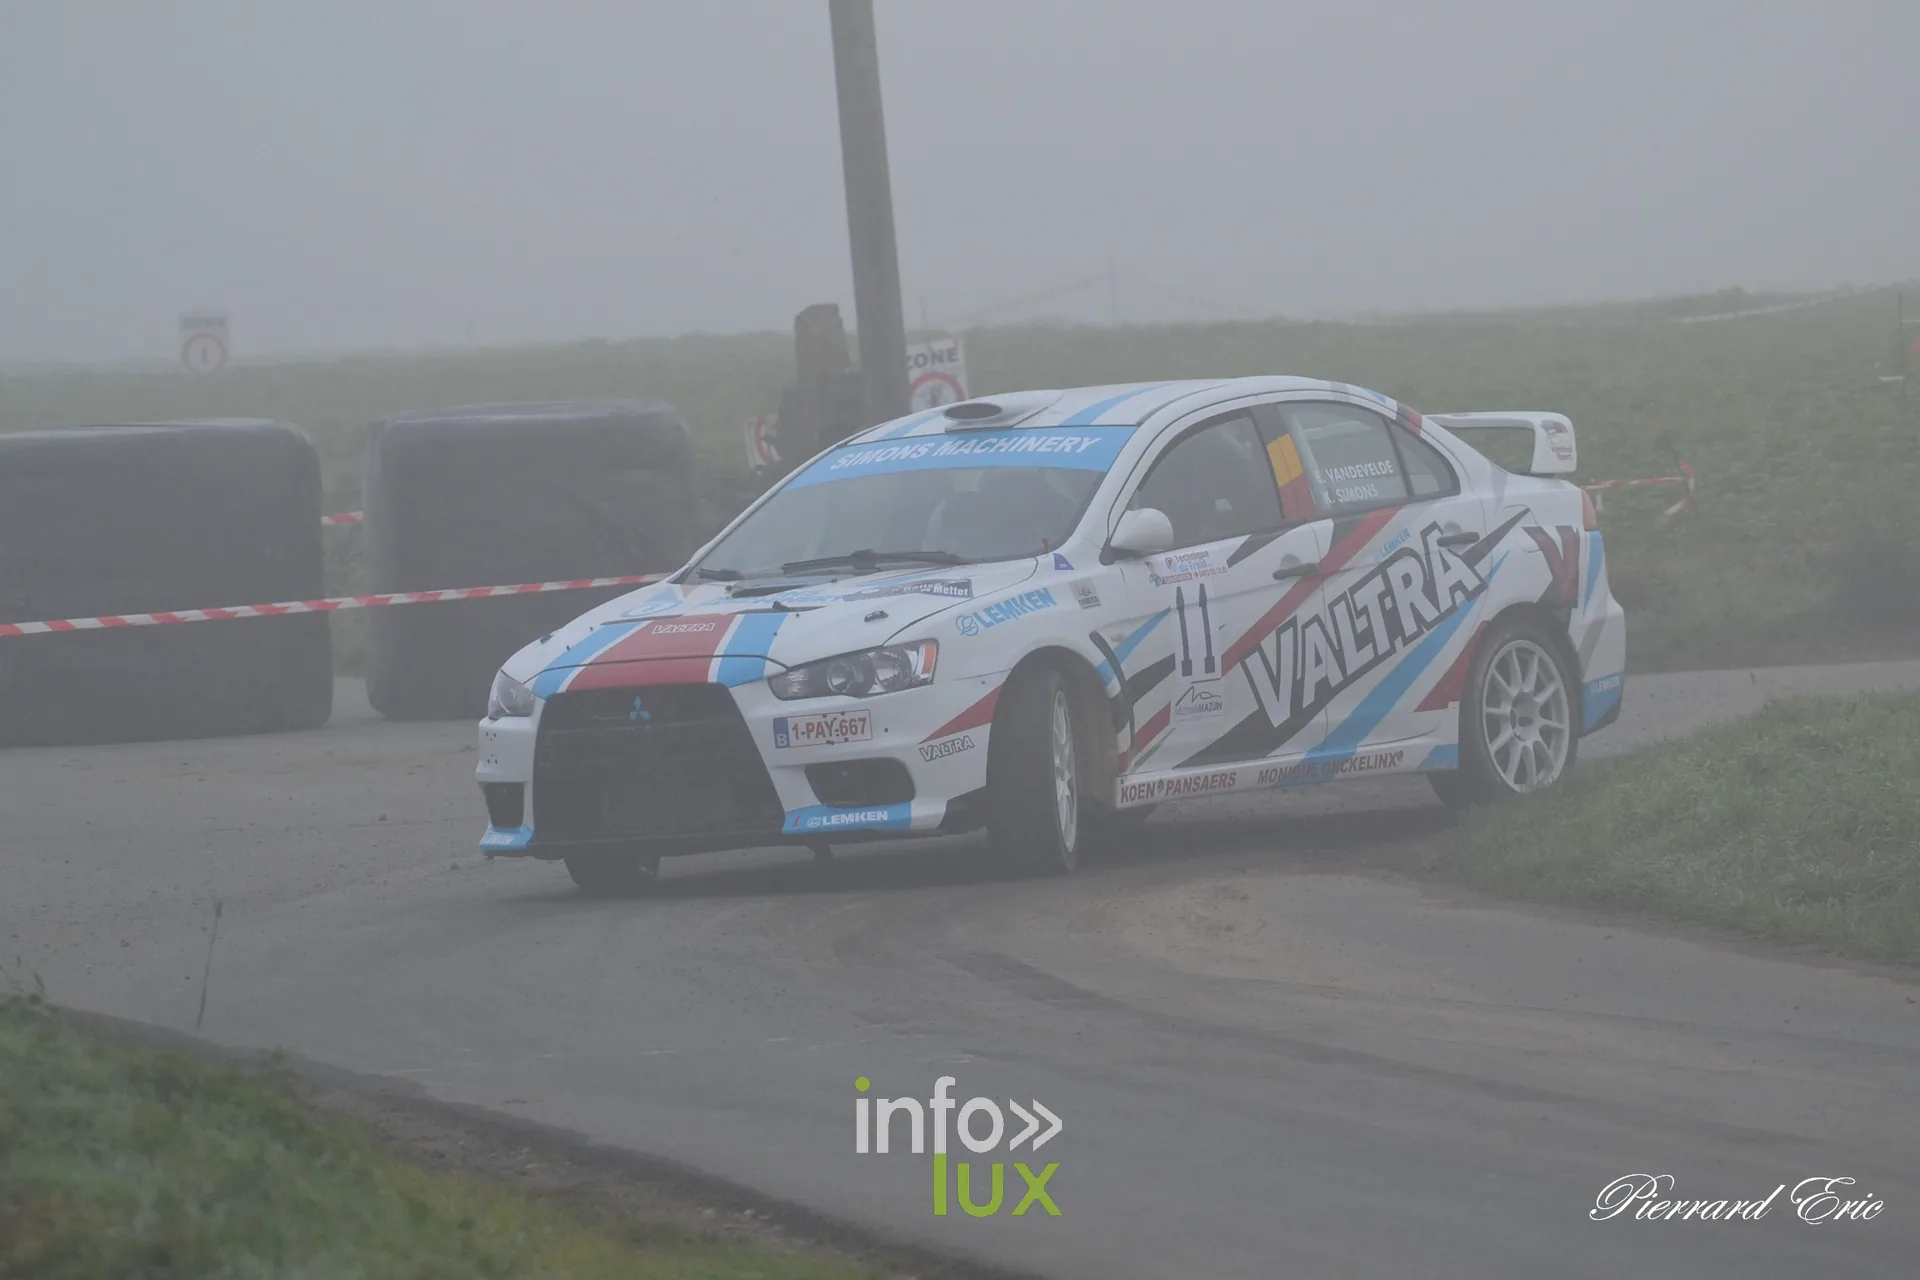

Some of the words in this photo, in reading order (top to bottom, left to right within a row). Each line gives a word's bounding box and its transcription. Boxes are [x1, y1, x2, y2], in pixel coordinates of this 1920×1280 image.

[829, 442, 937, 471] SIMONS
[931, 436, 1101, 457] MACHINERY
[1325, 460, 1394, 482] VANDEVELDE
[1336, 484, 1379, 503] SIMONS
[1174, 550, 1210, 563] Technique
[933, 584, 968, 596] Mettet
[972, 587, 1059, 629] LEMKEN
[651, 621, 716, 635] VALTRA
[1176, 583, 1216, 677] 11
[1240, 521, 1488, 729] VALTRA
[776, 732, 789, 748] B
[791, 717, 868, 741] 1-PAY-667
[918, 735, 975, 762] VALTRA
[1257, 760, 1318, 785] MONIQUE
[1120, 784, 1155, 803] KOEN
[1165, 772, 1236, 796] PANSAERS
[822, 810, 889, 826] LEMKEN
